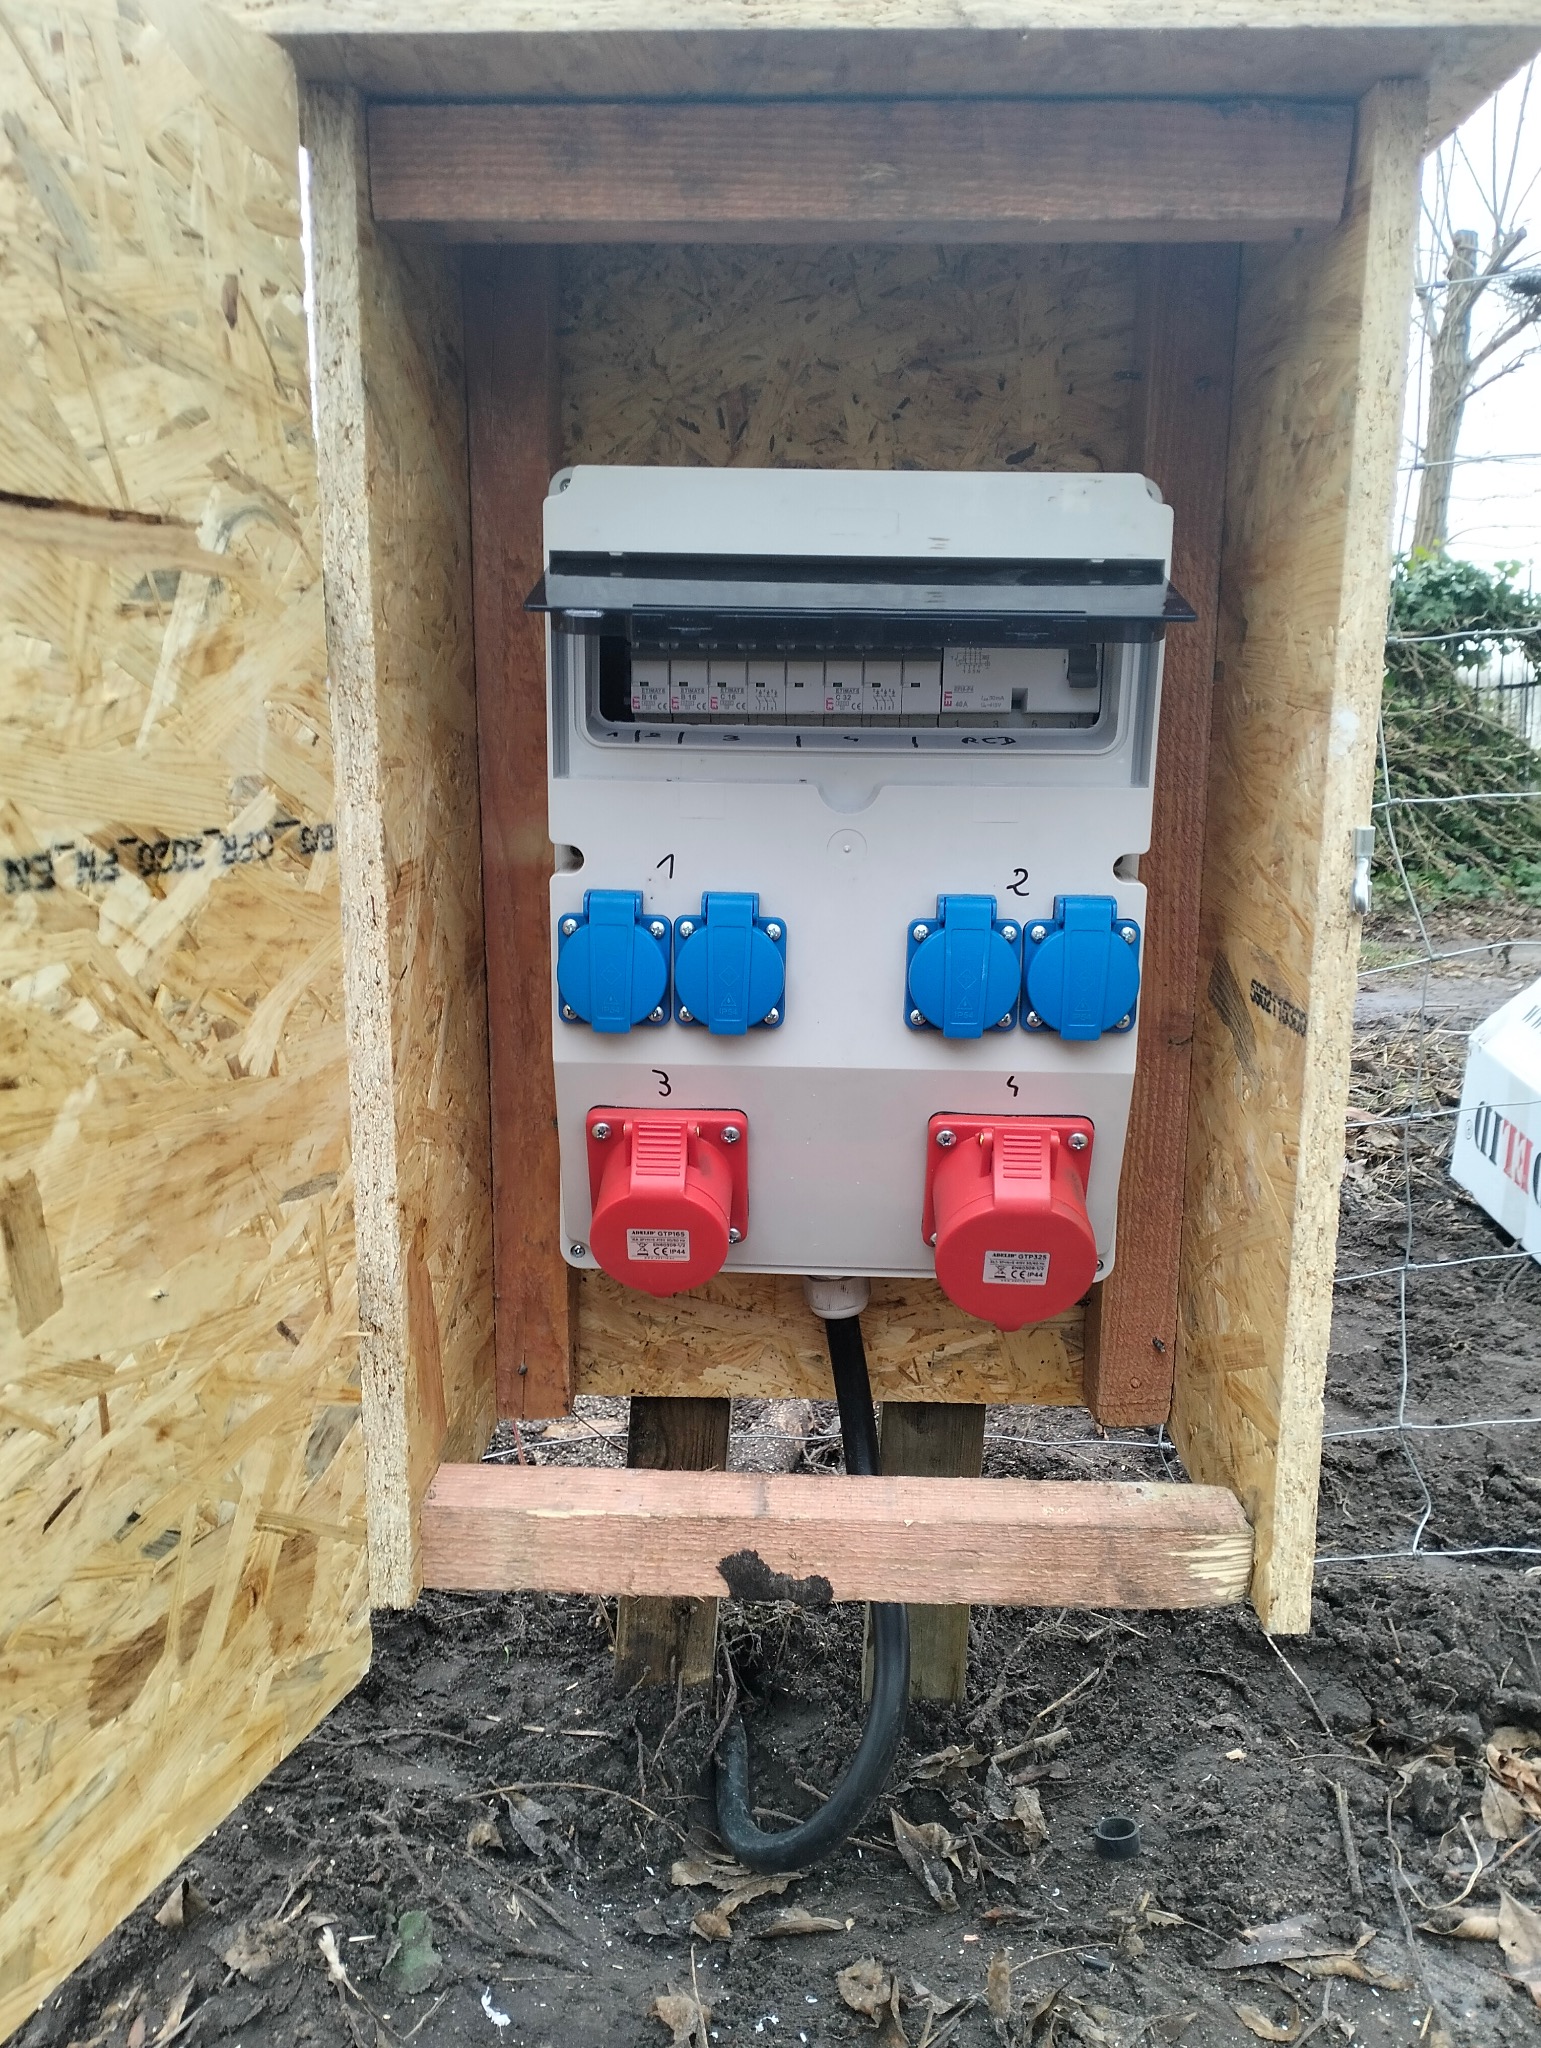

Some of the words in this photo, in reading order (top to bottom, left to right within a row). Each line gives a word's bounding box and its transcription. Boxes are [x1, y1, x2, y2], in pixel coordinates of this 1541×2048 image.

[826, 698, 834, 710] ETI
[944, 691, 952, 706] ETI
[961, 736, 1016, 745] RCD
[656, 854, 674, 879] 1
[1006, 868, 1030, 897] 2
[719, 1008, 738, 1016] IP54
[954, 1010, 973, 1019] IP54
[652, 1070, 672, 1097] 3
[1006, 1076, 1018, 1097] 4
